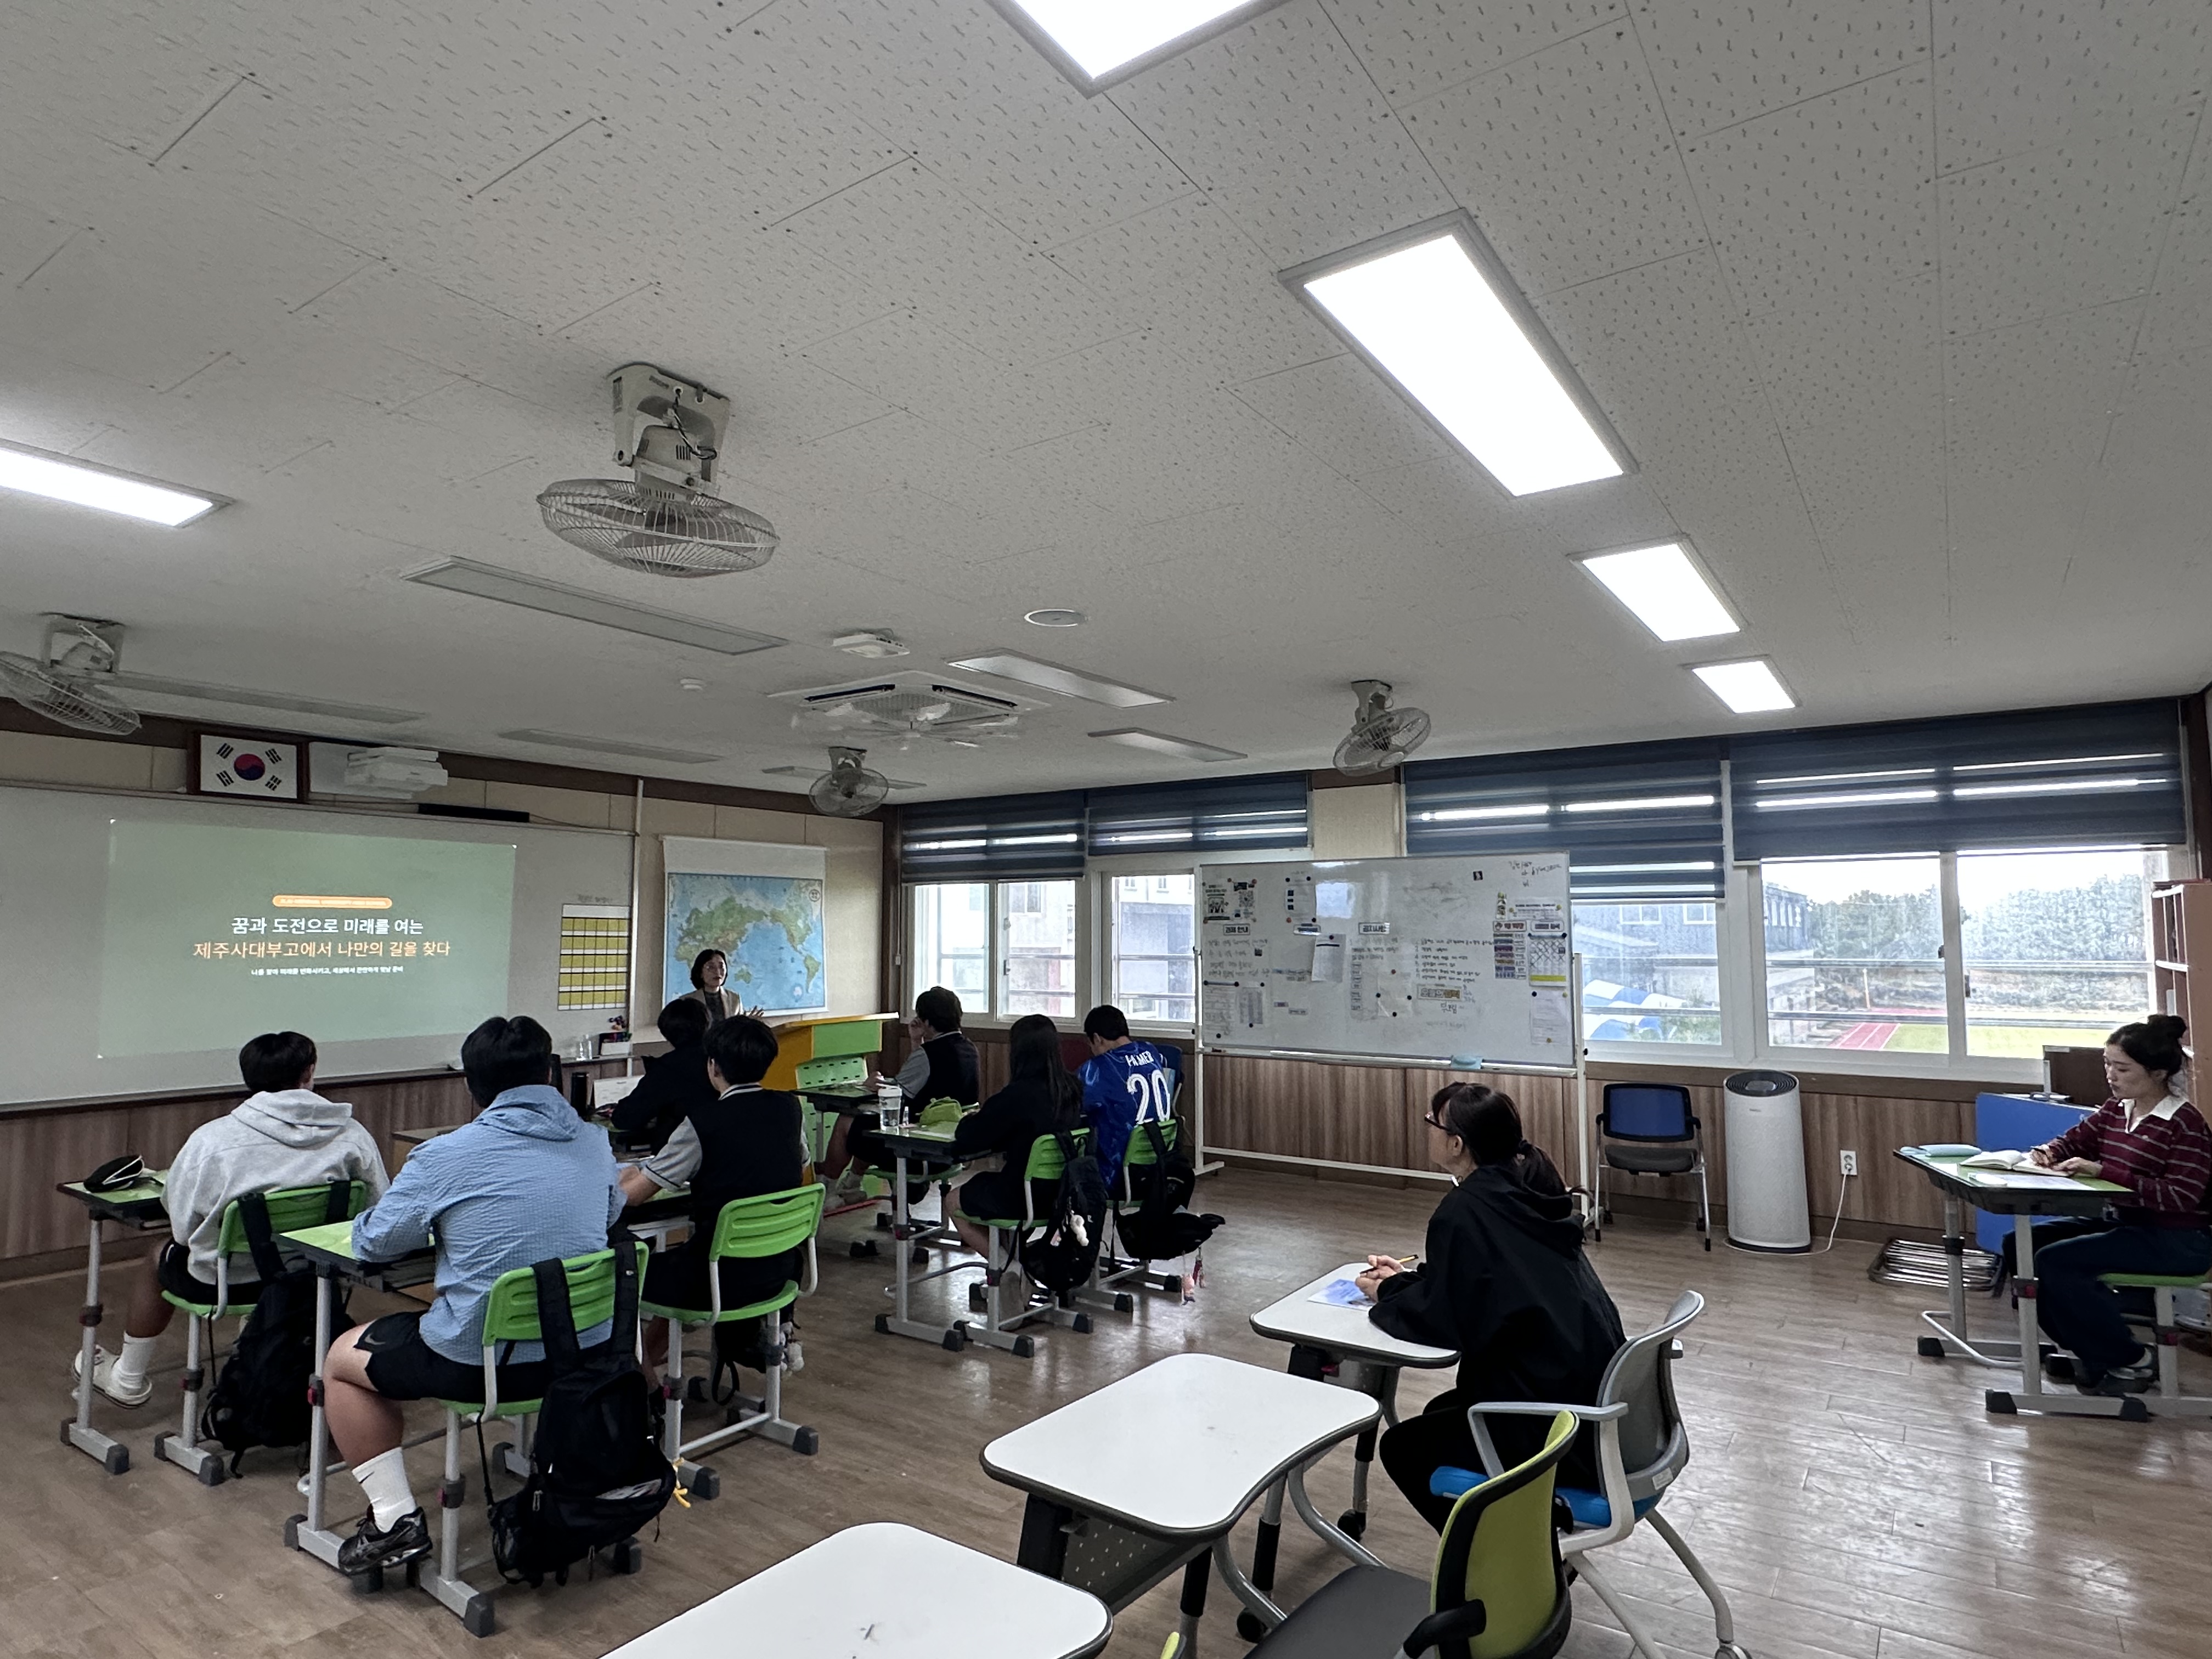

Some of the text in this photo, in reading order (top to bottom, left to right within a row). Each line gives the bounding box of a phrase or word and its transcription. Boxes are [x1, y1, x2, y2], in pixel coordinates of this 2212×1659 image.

[232, 917, 424, 935] 꿈과 도전으로 미래를 여는
[193, 941, 450, 959] 제주사대부고에서 나만의 길을 찾다
[1126, 1069, 1171, 1126] 20
